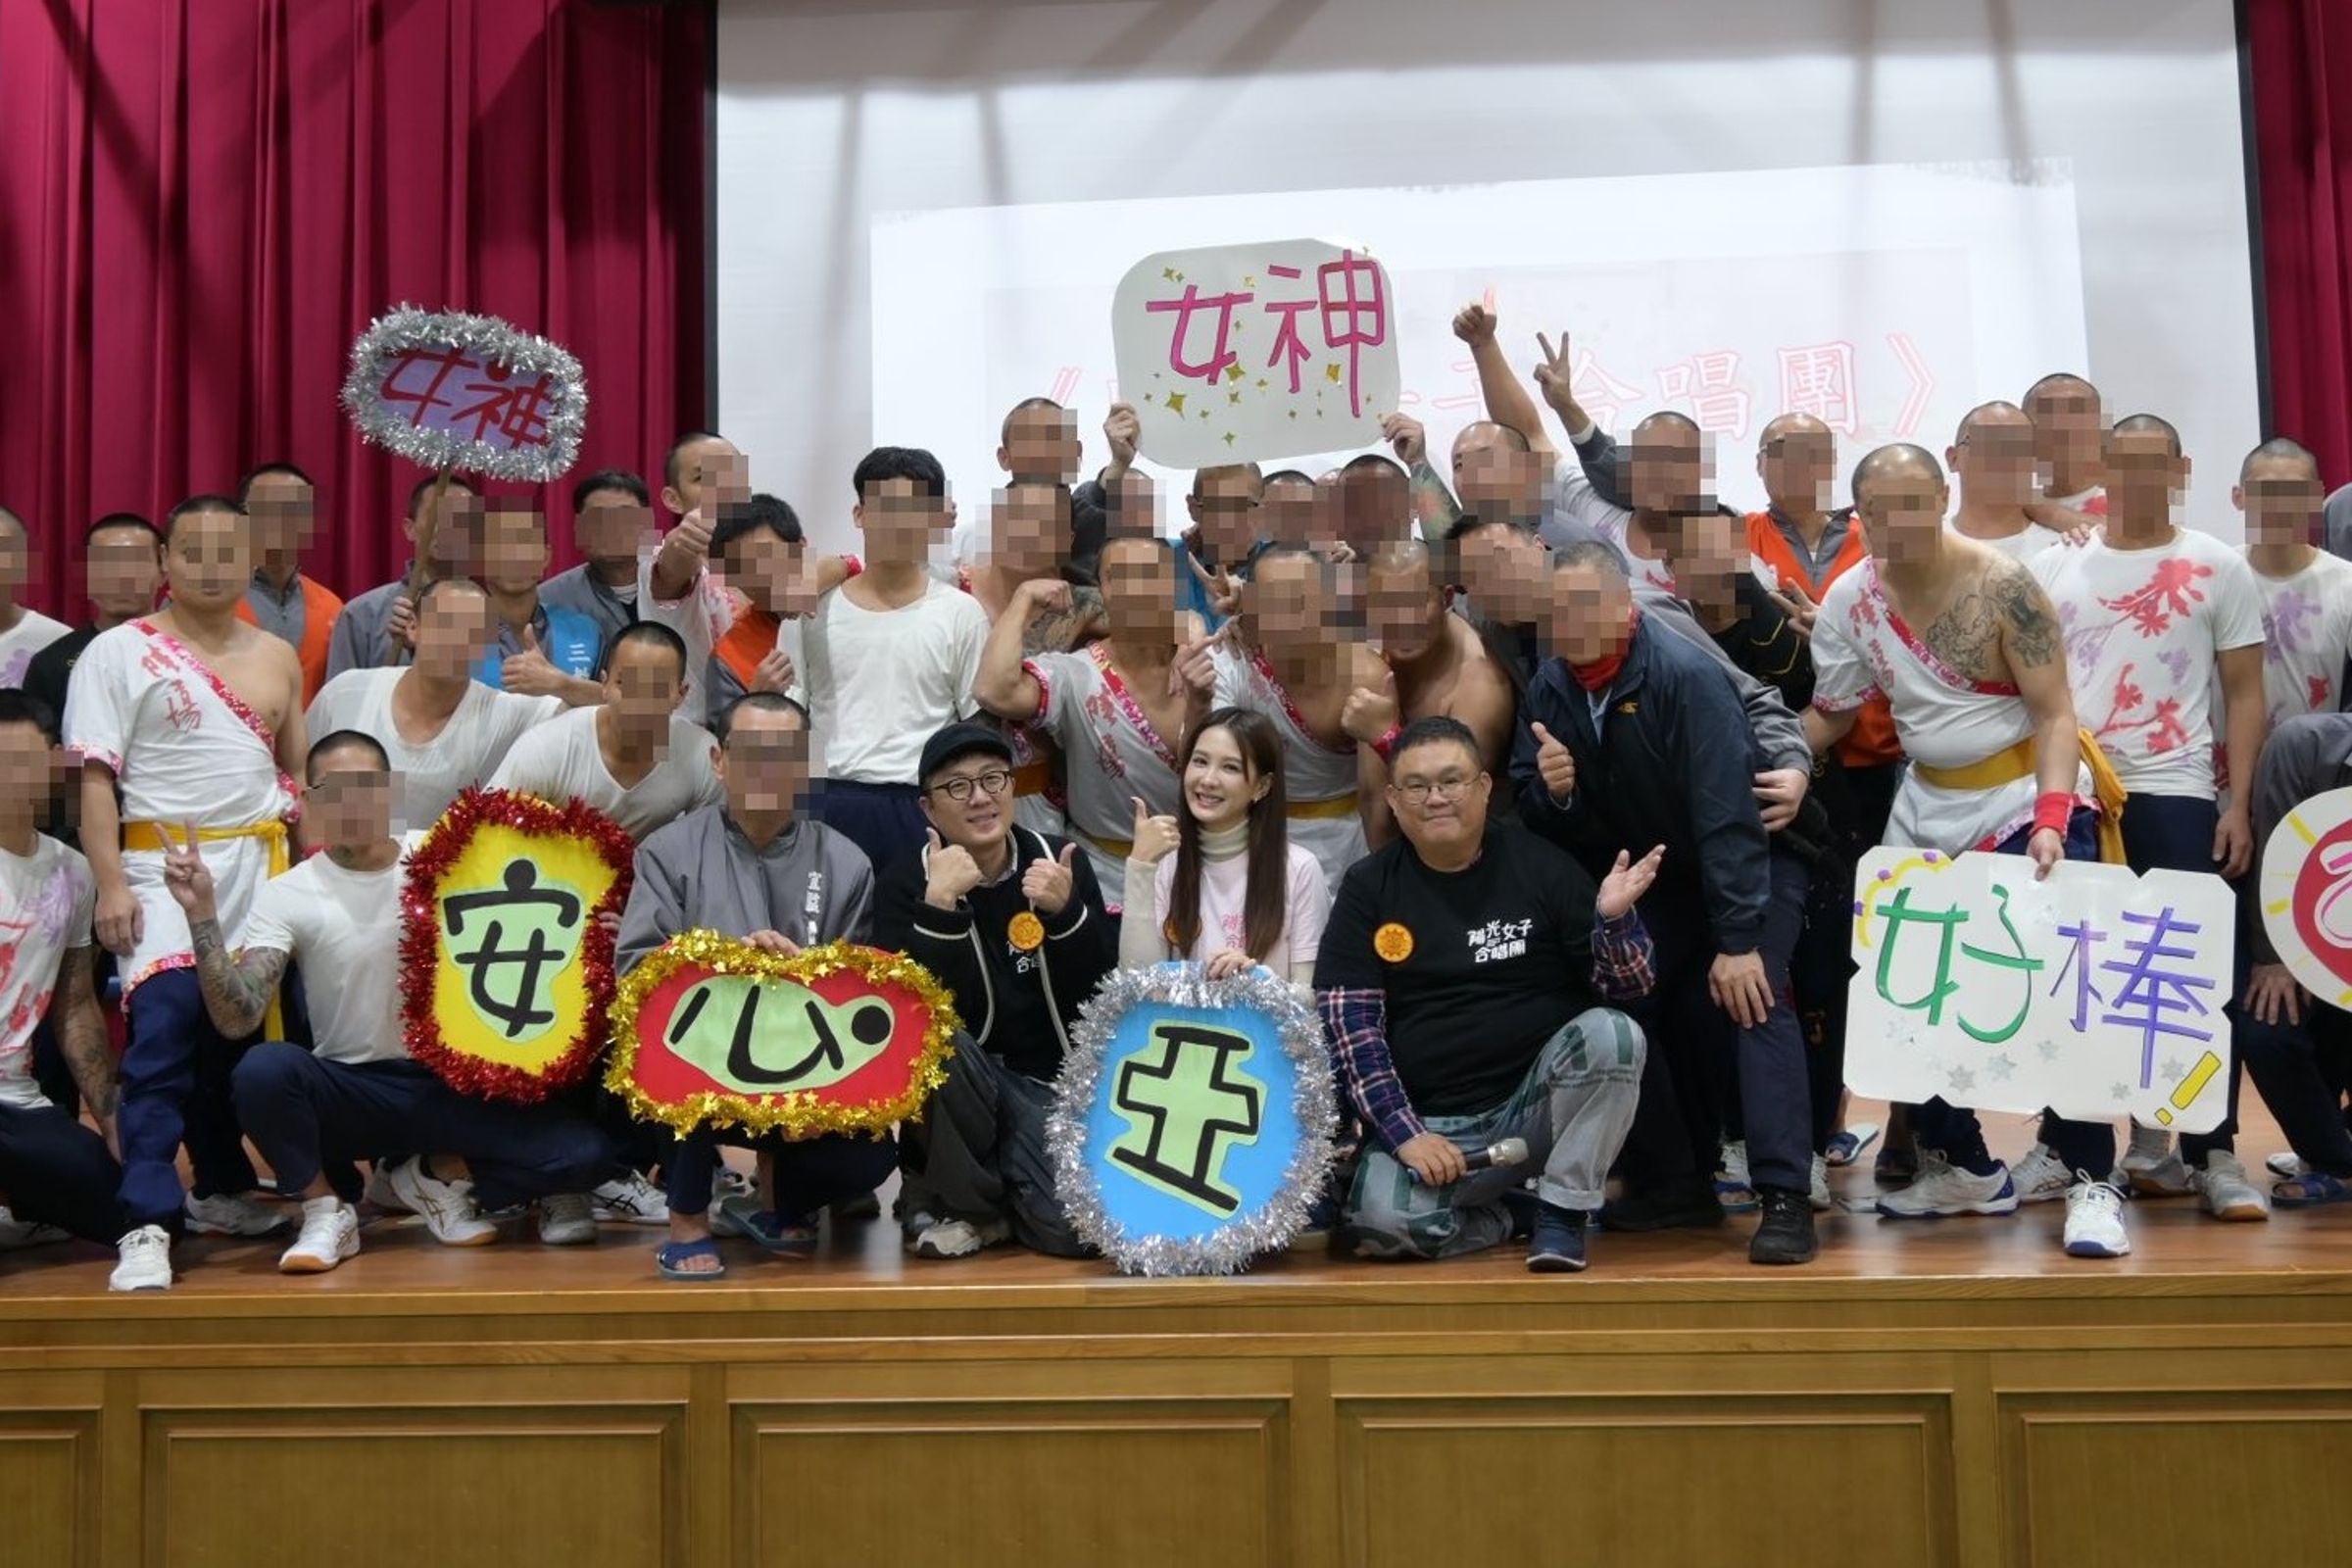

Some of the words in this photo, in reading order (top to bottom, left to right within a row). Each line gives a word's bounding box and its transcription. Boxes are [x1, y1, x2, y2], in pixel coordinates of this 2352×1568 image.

[1146, 249, 1385, 418] 女神
[379, 346, 553, 450] 女神
[443, 858, 581, 1037] 安
[1467, 918, 1533, 947] 陽光女子
[1475, 939, 1526, 962] 合唱團
[668, 985, 892, 1085] 心
